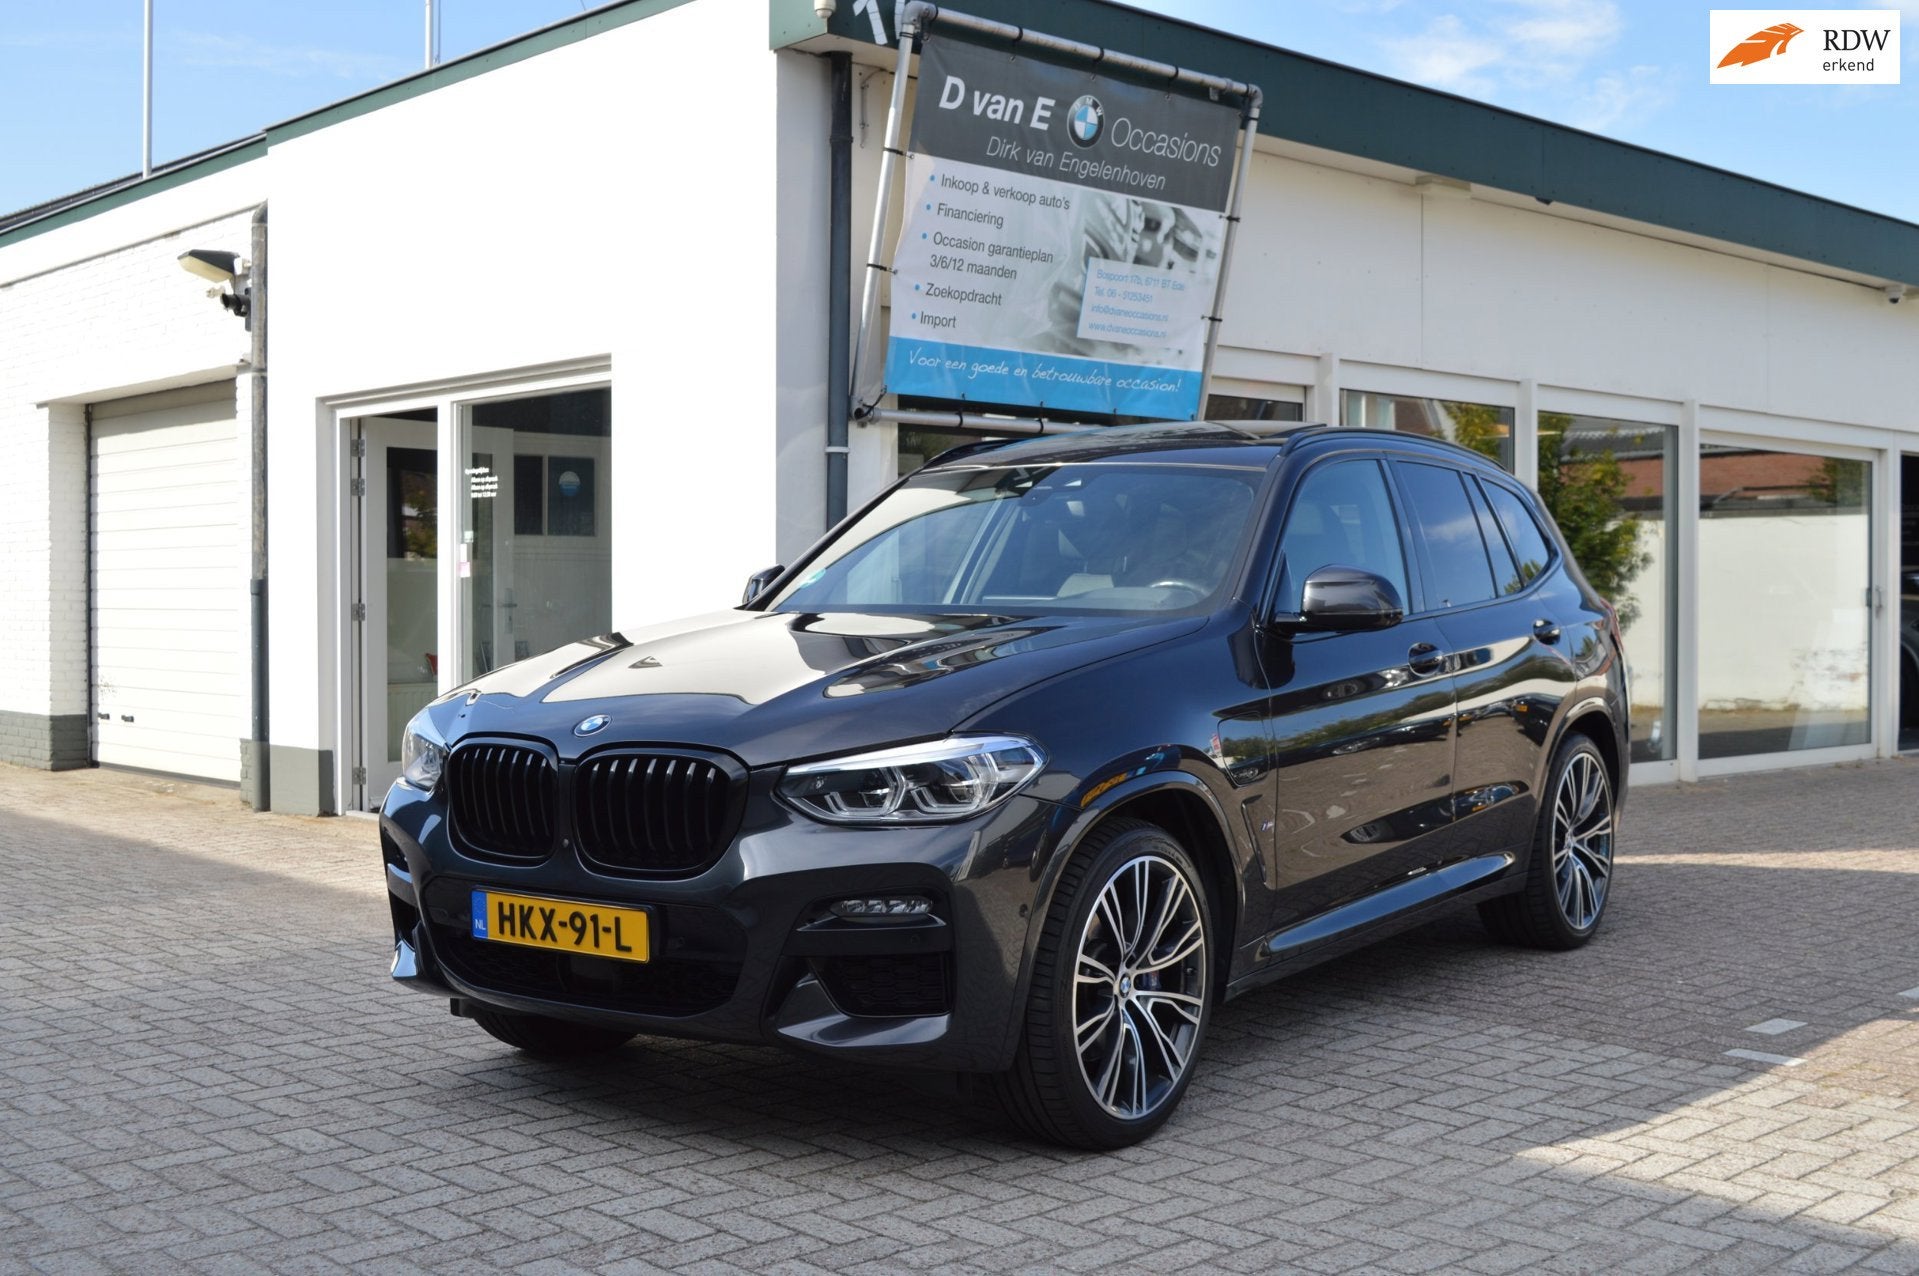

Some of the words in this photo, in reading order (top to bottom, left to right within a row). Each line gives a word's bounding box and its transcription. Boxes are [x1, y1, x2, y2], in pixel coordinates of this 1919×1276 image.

[938, 75, 966, 110] D
[973, 90, 1024, 124] van
[1029, 96, 1056, 131] E
[1110, 117, 1221, 167] Occasions
[986, 136, 1022, 161] Dirk
[1026, 149, 1054, 168] van
[1059, 151, 1166, 190] Engelenhoven
[941, 174, 979, 195] Inkoop
[981, 181, 990, 195] &
[994, 186, 1036, 206] verkoop
[1038, 195, 1071, 210] auto's
[937, 202, 1004, 229] Financiering
[933, 231, 985, 252] Occasion
[987, 242, 1054, 263] garantieplan
[930, 254, 965, 272] 3/6/12
[966, 261, 1017, 279] maanden
[925, 282, 1002, 306] Zoekopdracht
[920, 311, 957, 328] Import
[909, 347, 941, 367] Voor
[944, 360, 967, 371] een
[967, 360, 1009, 380] goede
[1013, 366, 1028, 377] en
[1031, 363, 1112, 386] betrouwbare
[1116, 378, 1181, 392] occasion!
[475, 918, 486, 931] NL
[497, 901, 632, 953] HKX-91-L
